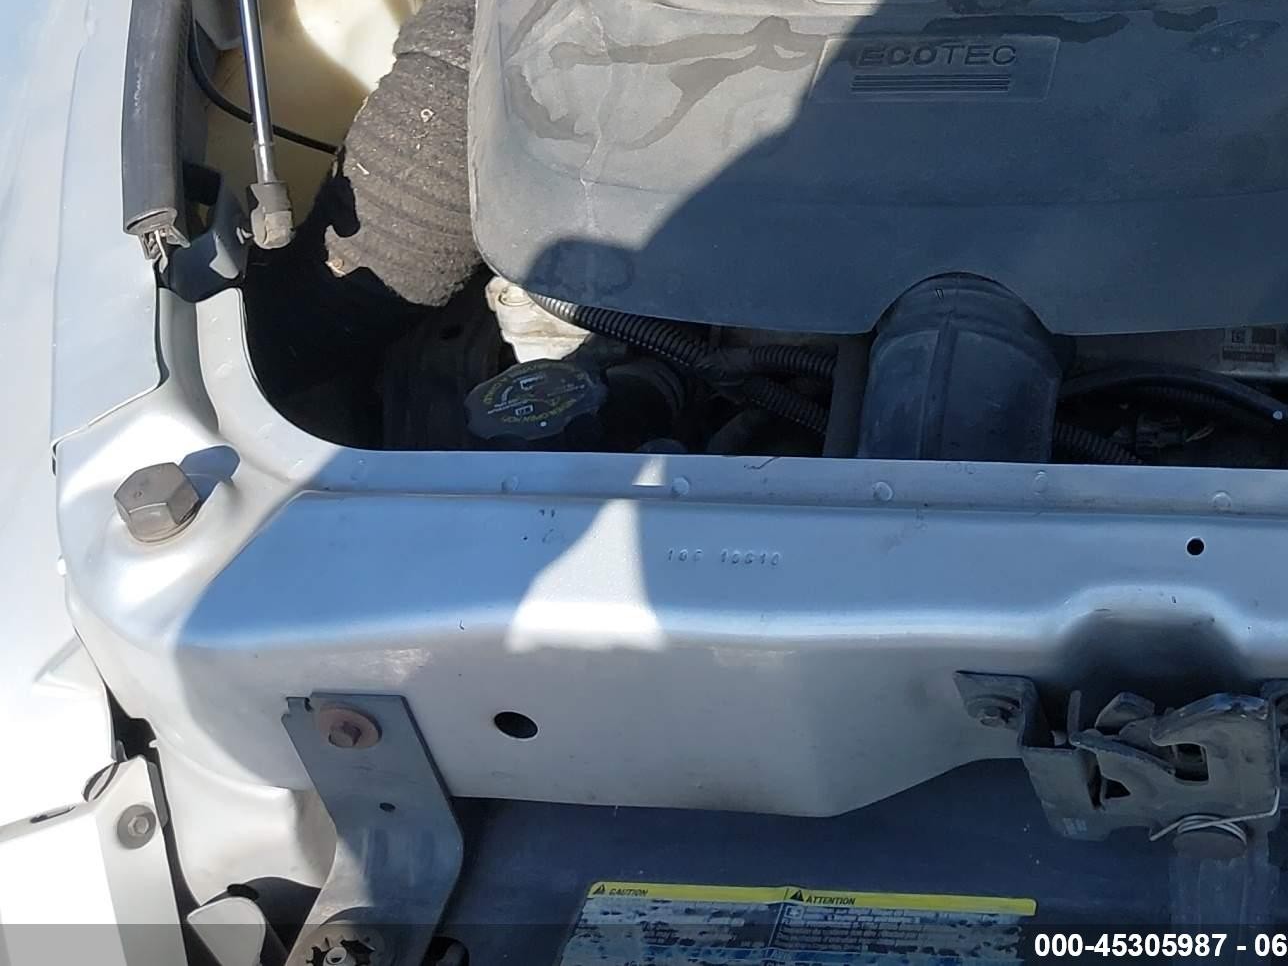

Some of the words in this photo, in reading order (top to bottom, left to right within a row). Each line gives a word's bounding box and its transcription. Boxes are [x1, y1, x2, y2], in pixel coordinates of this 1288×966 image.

[858, 44, 1017, 66] ECOTEC
[609, 888, 649, 897] CAUTION
[806, 895, 856, 906] ATTENTION
